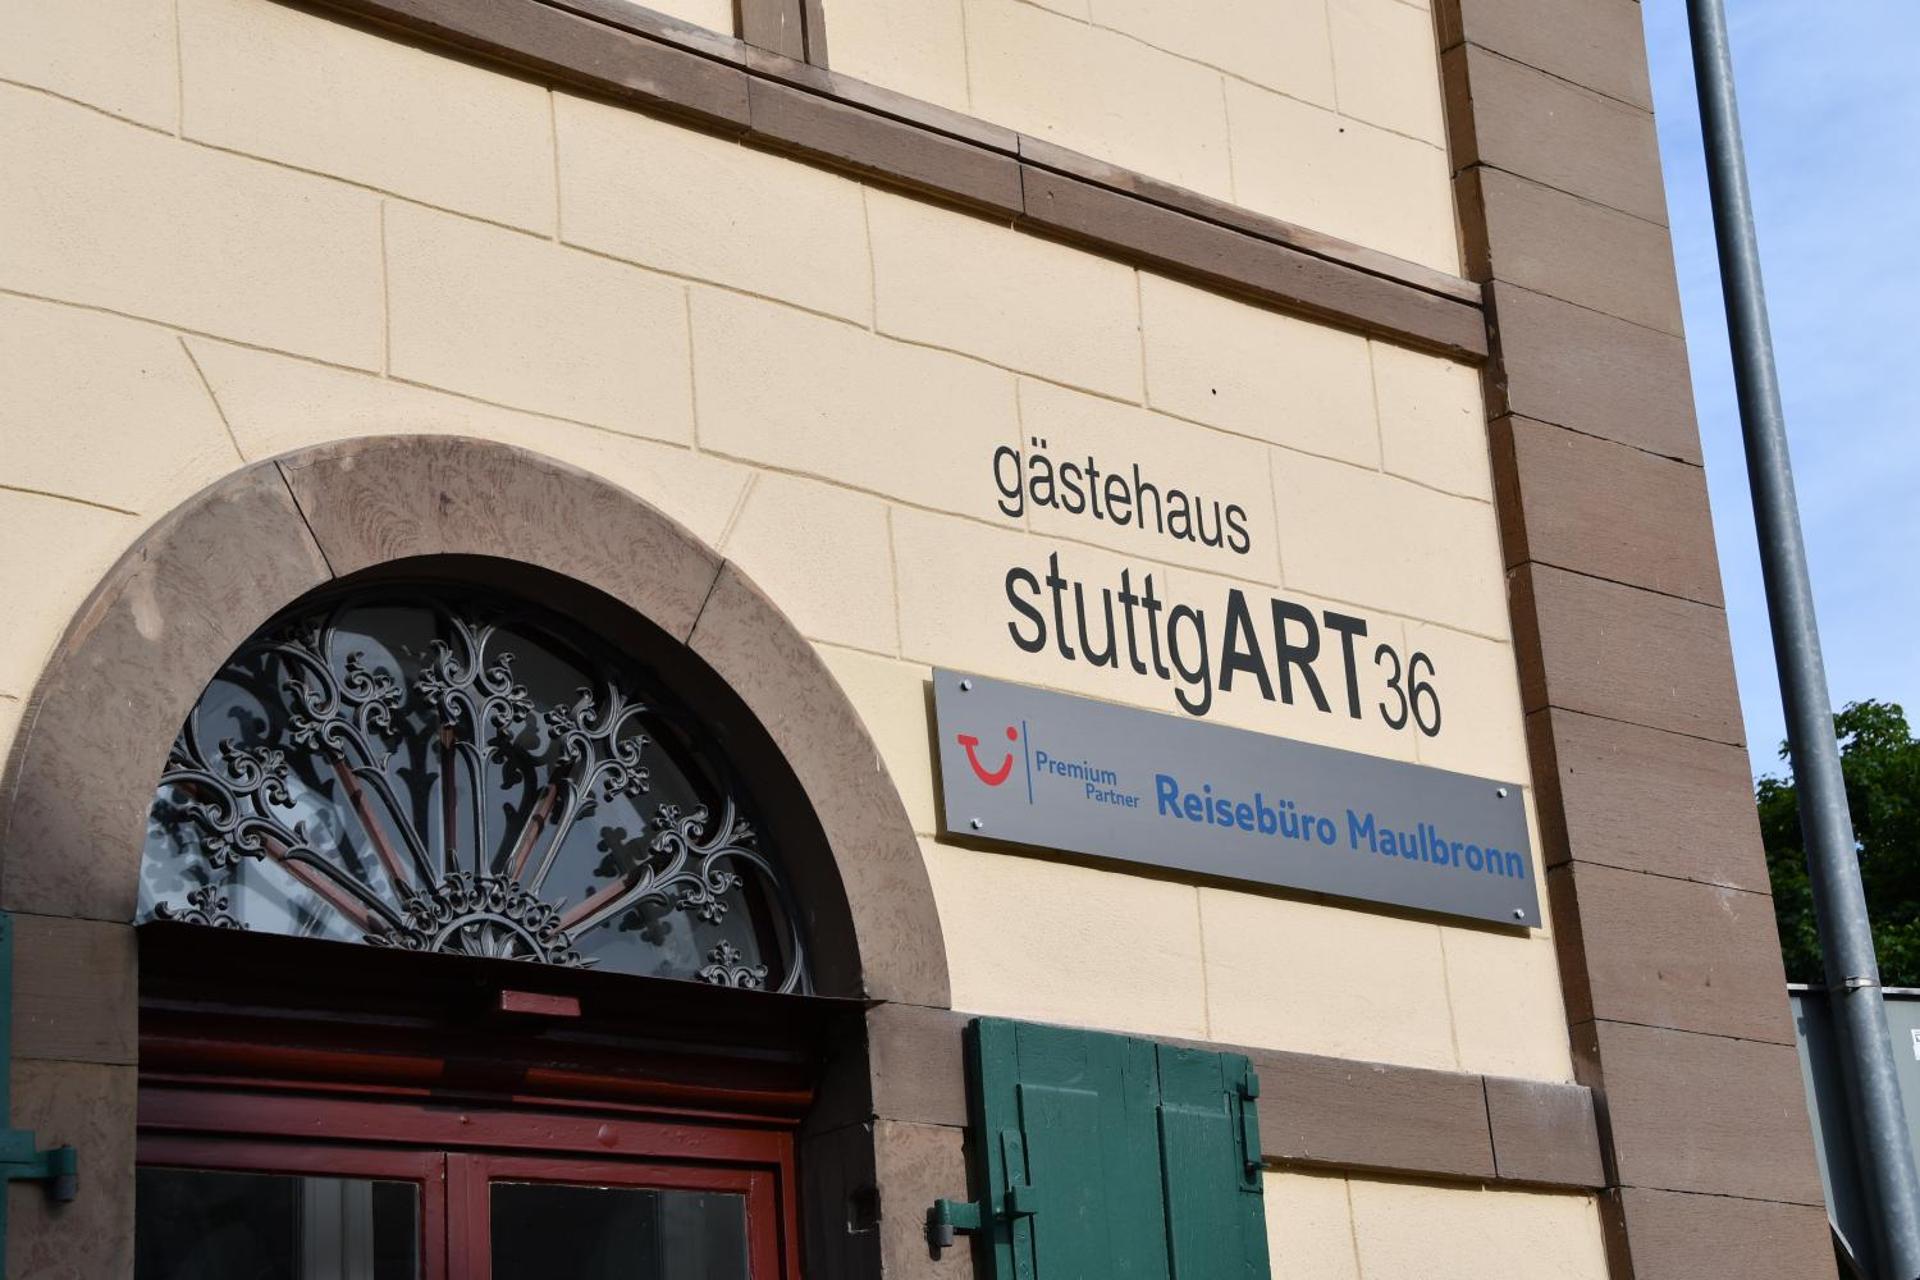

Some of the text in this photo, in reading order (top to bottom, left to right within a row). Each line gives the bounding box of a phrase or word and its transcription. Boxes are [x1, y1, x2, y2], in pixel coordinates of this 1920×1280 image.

[993, 437, 1250, 555] gästehaus
[1036, 751, 1117, 786] Premium
[1085, 783, 1140, 808] Partner
[1155, 773, 1525, 880] Reisebüro Maulbronn
